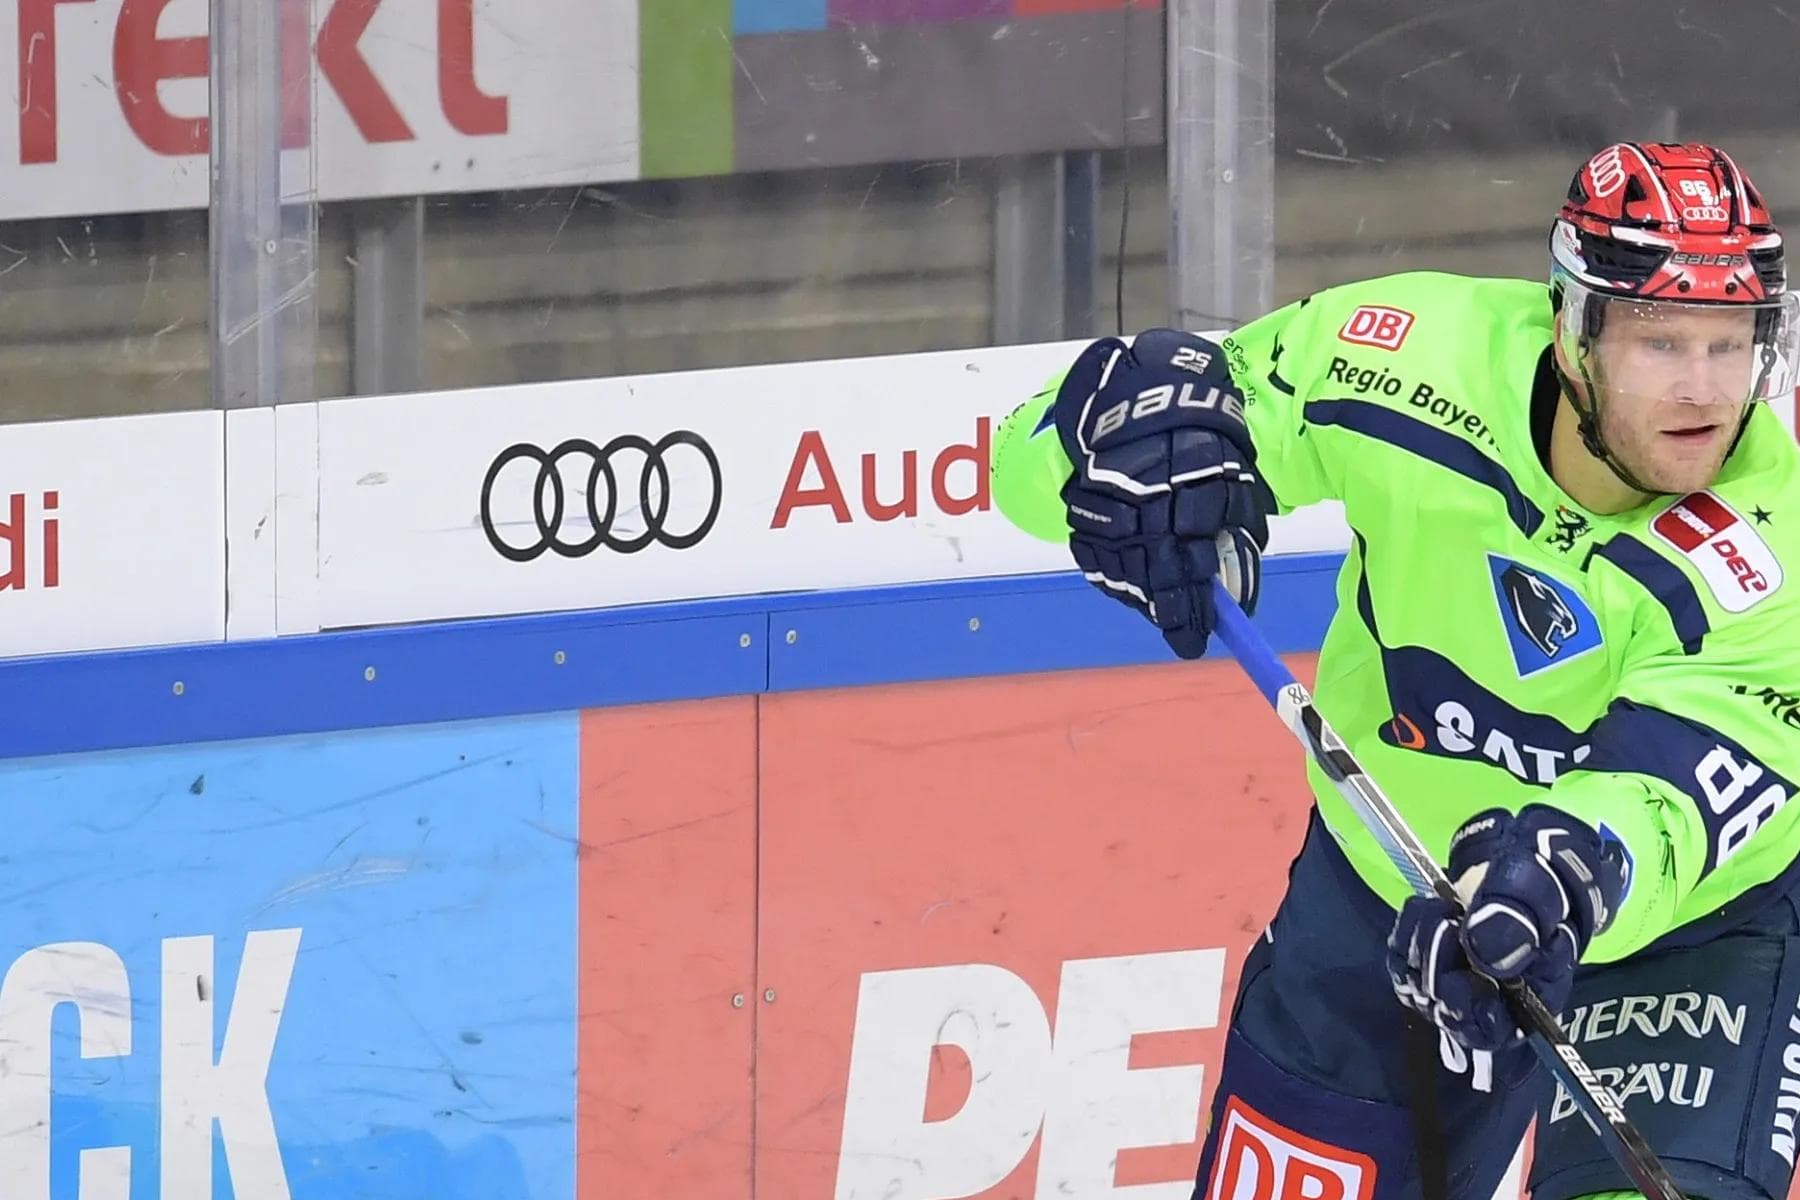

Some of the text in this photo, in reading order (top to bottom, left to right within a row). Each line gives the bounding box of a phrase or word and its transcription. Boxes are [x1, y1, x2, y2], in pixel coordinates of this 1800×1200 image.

[1349, 309, 1402, 342] DB
[1326, 356, 1402, 397] Regio
[1090, 383, 1247, 446] BAUE
[773, 416, 991, 529] Aud
[0, 490, 60, 591] di
[1711, 538, 1768, 593] DEL
[1553, 1043, 1627, 1125] BAUER
